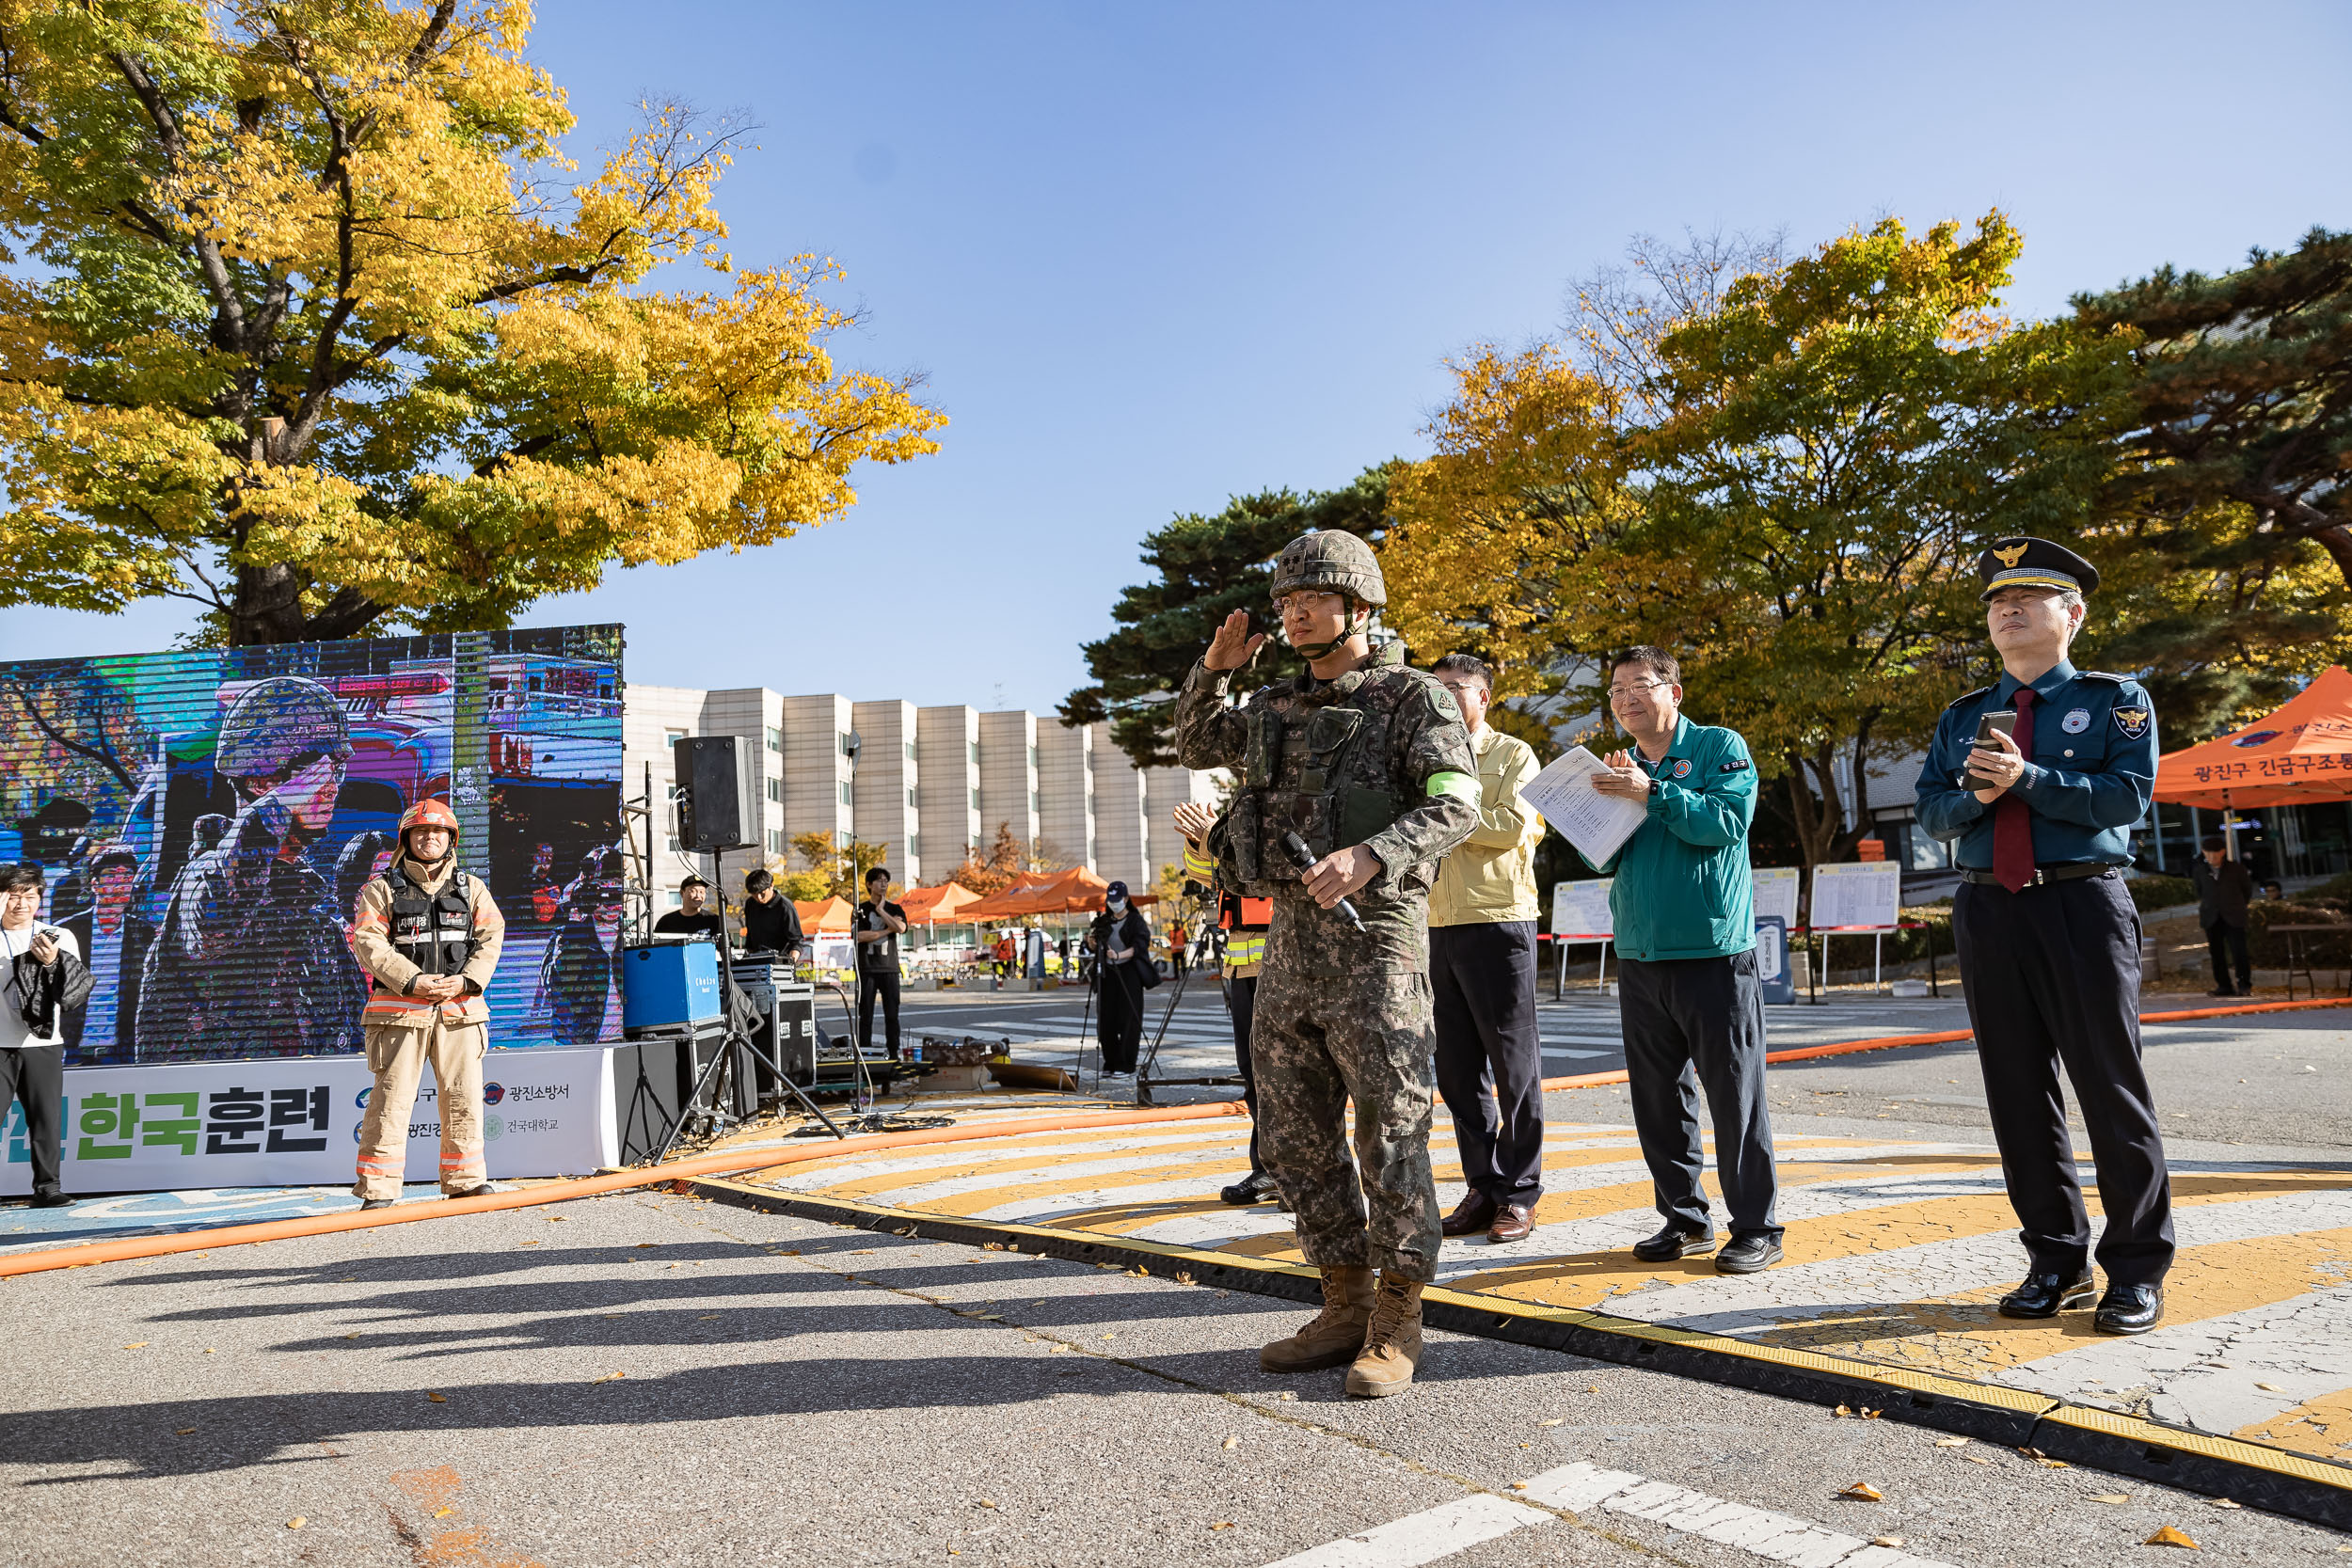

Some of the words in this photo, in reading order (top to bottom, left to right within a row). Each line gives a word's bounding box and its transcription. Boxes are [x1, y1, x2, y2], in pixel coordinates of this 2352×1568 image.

[1724, 760, 1745, 769] 광진구
[2194, 762, 2250, 783] 광진구
[509, 1084, 569, 1102] 광진소방서
[507, 1118, 559, 1134] 건국대학교
